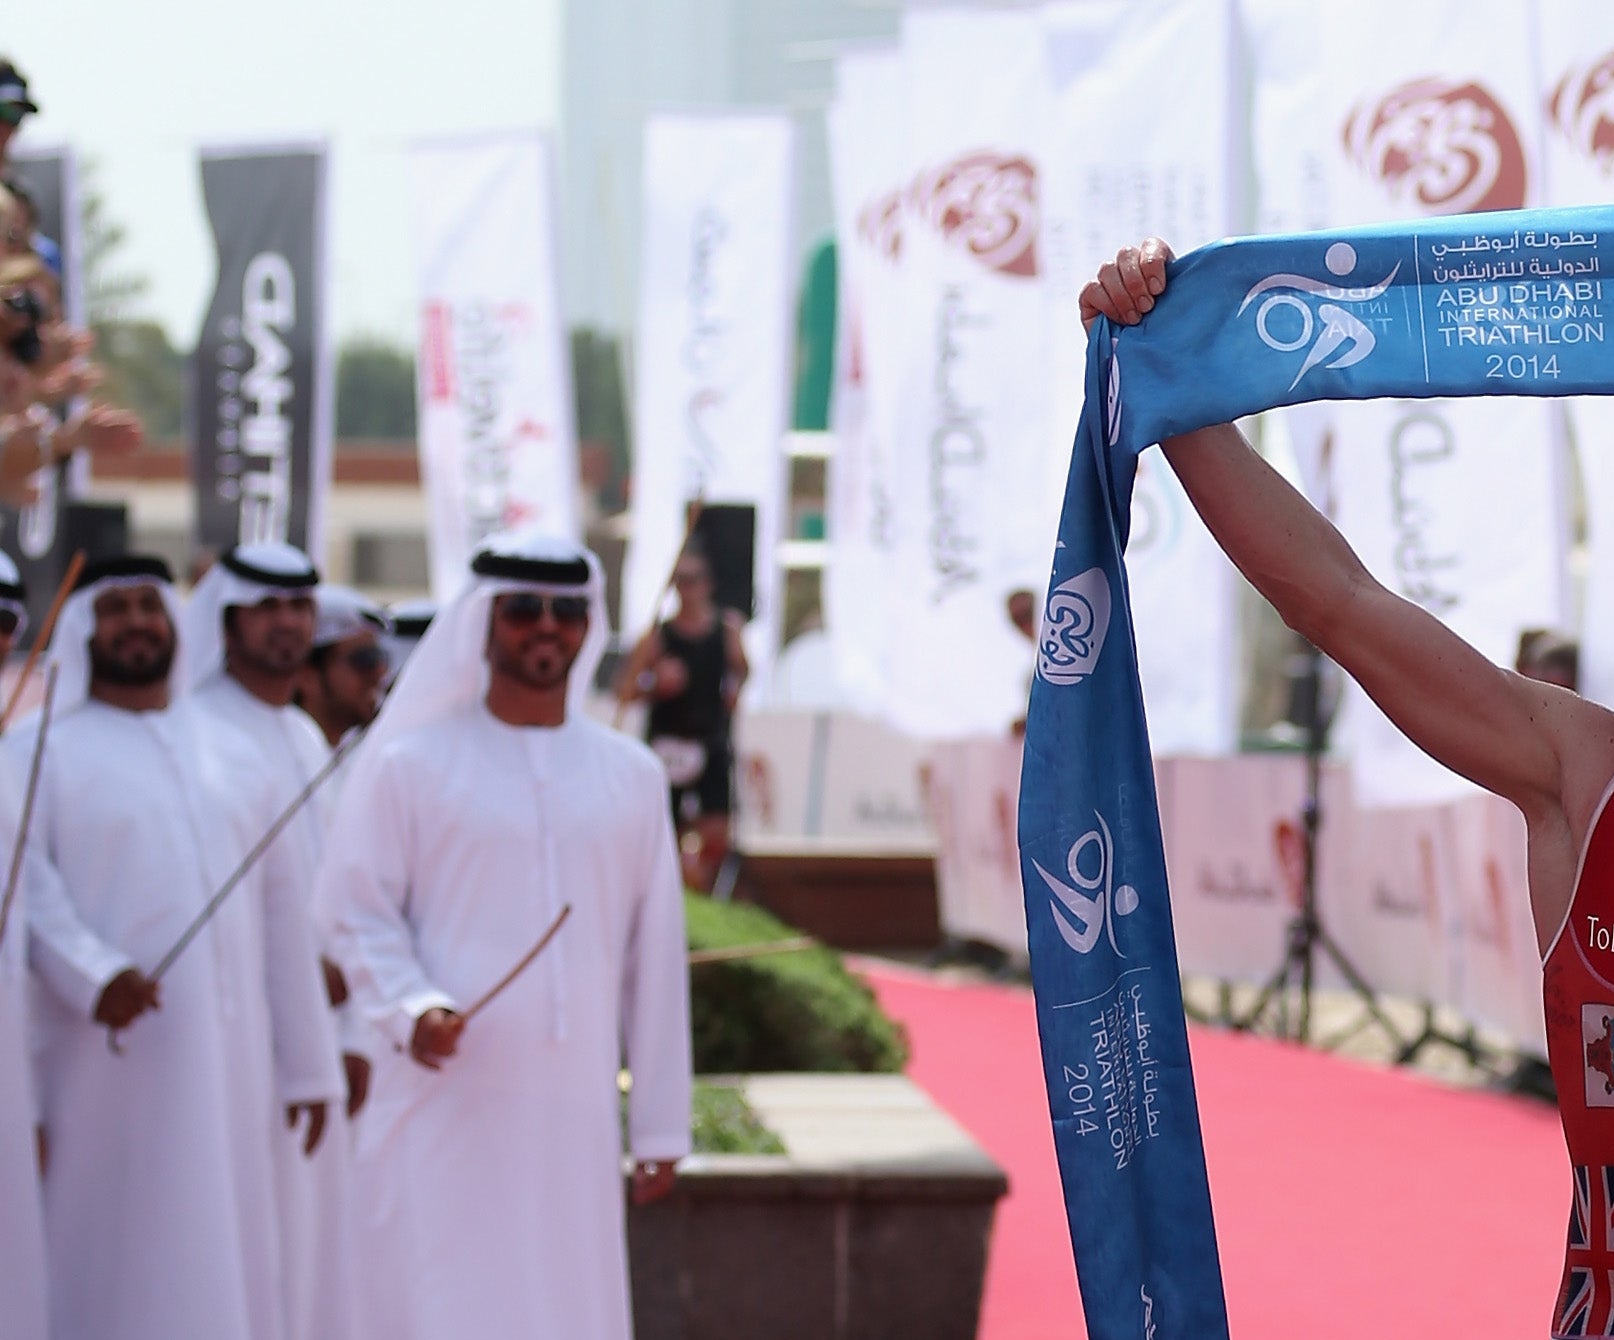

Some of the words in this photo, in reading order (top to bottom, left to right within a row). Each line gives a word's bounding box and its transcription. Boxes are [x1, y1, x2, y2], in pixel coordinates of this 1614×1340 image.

[1437, 285, 1503, 308] ABU
[1510, 281, 1601, 303] DHABI
[1440, 304, 1603, 323] INTERNATIONAL
[1439, 322, 1604, 347] TRIATHLON
[1486, 354, 1560, 379] 2014
[1063, 1063, 1100, 1137] 2014
[1090, 1010, 1129, 1171] TRIATHLON
